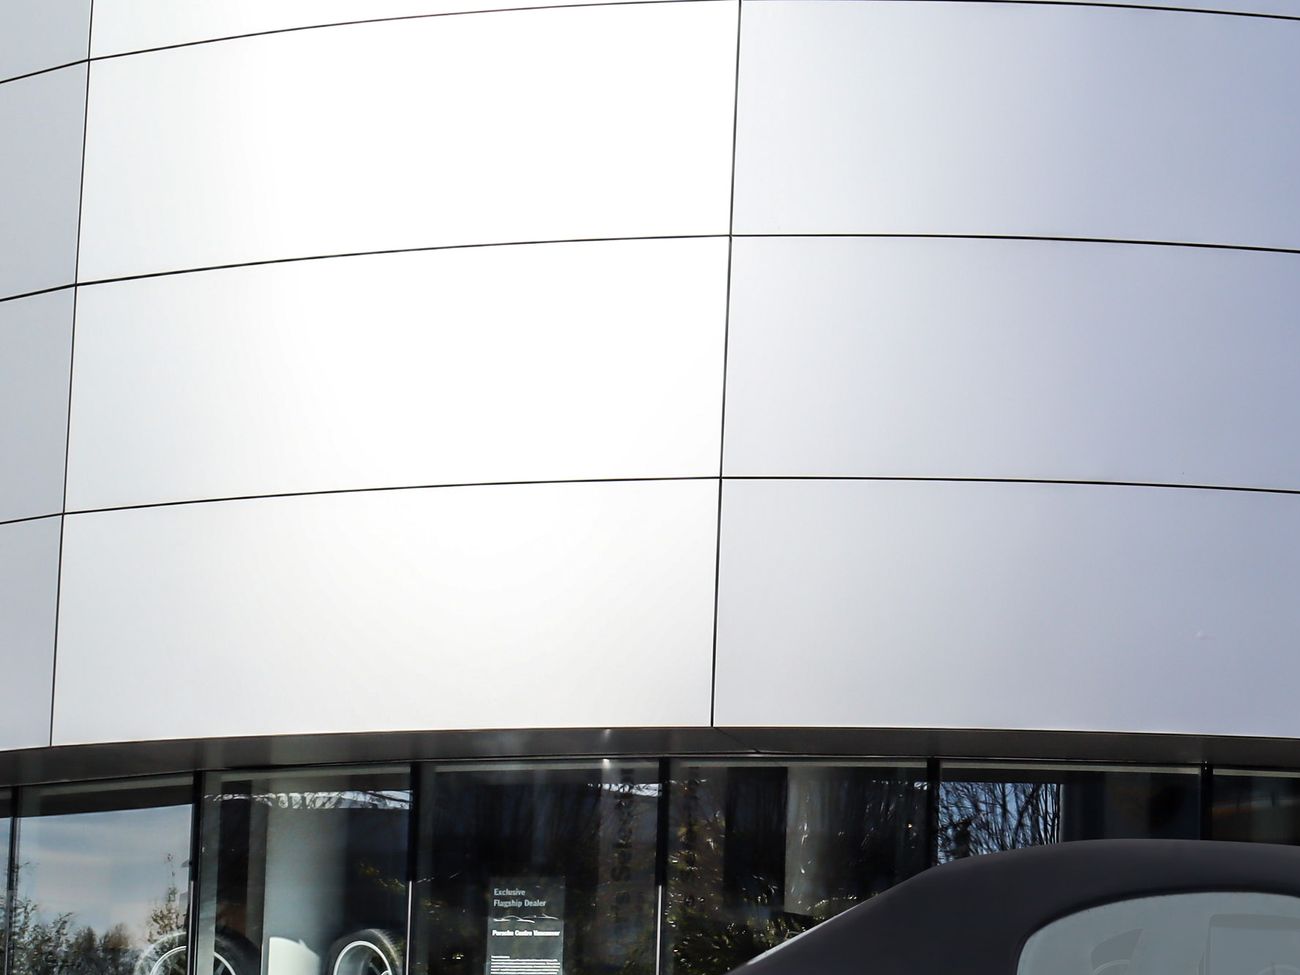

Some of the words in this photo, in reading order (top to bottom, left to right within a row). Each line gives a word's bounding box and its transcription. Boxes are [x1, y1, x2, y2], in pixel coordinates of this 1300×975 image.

[493, 888, 526, 896] Exclusive
[493, 899, 523, 907] Flagship
[524, 899, 546, 907] Dealer
